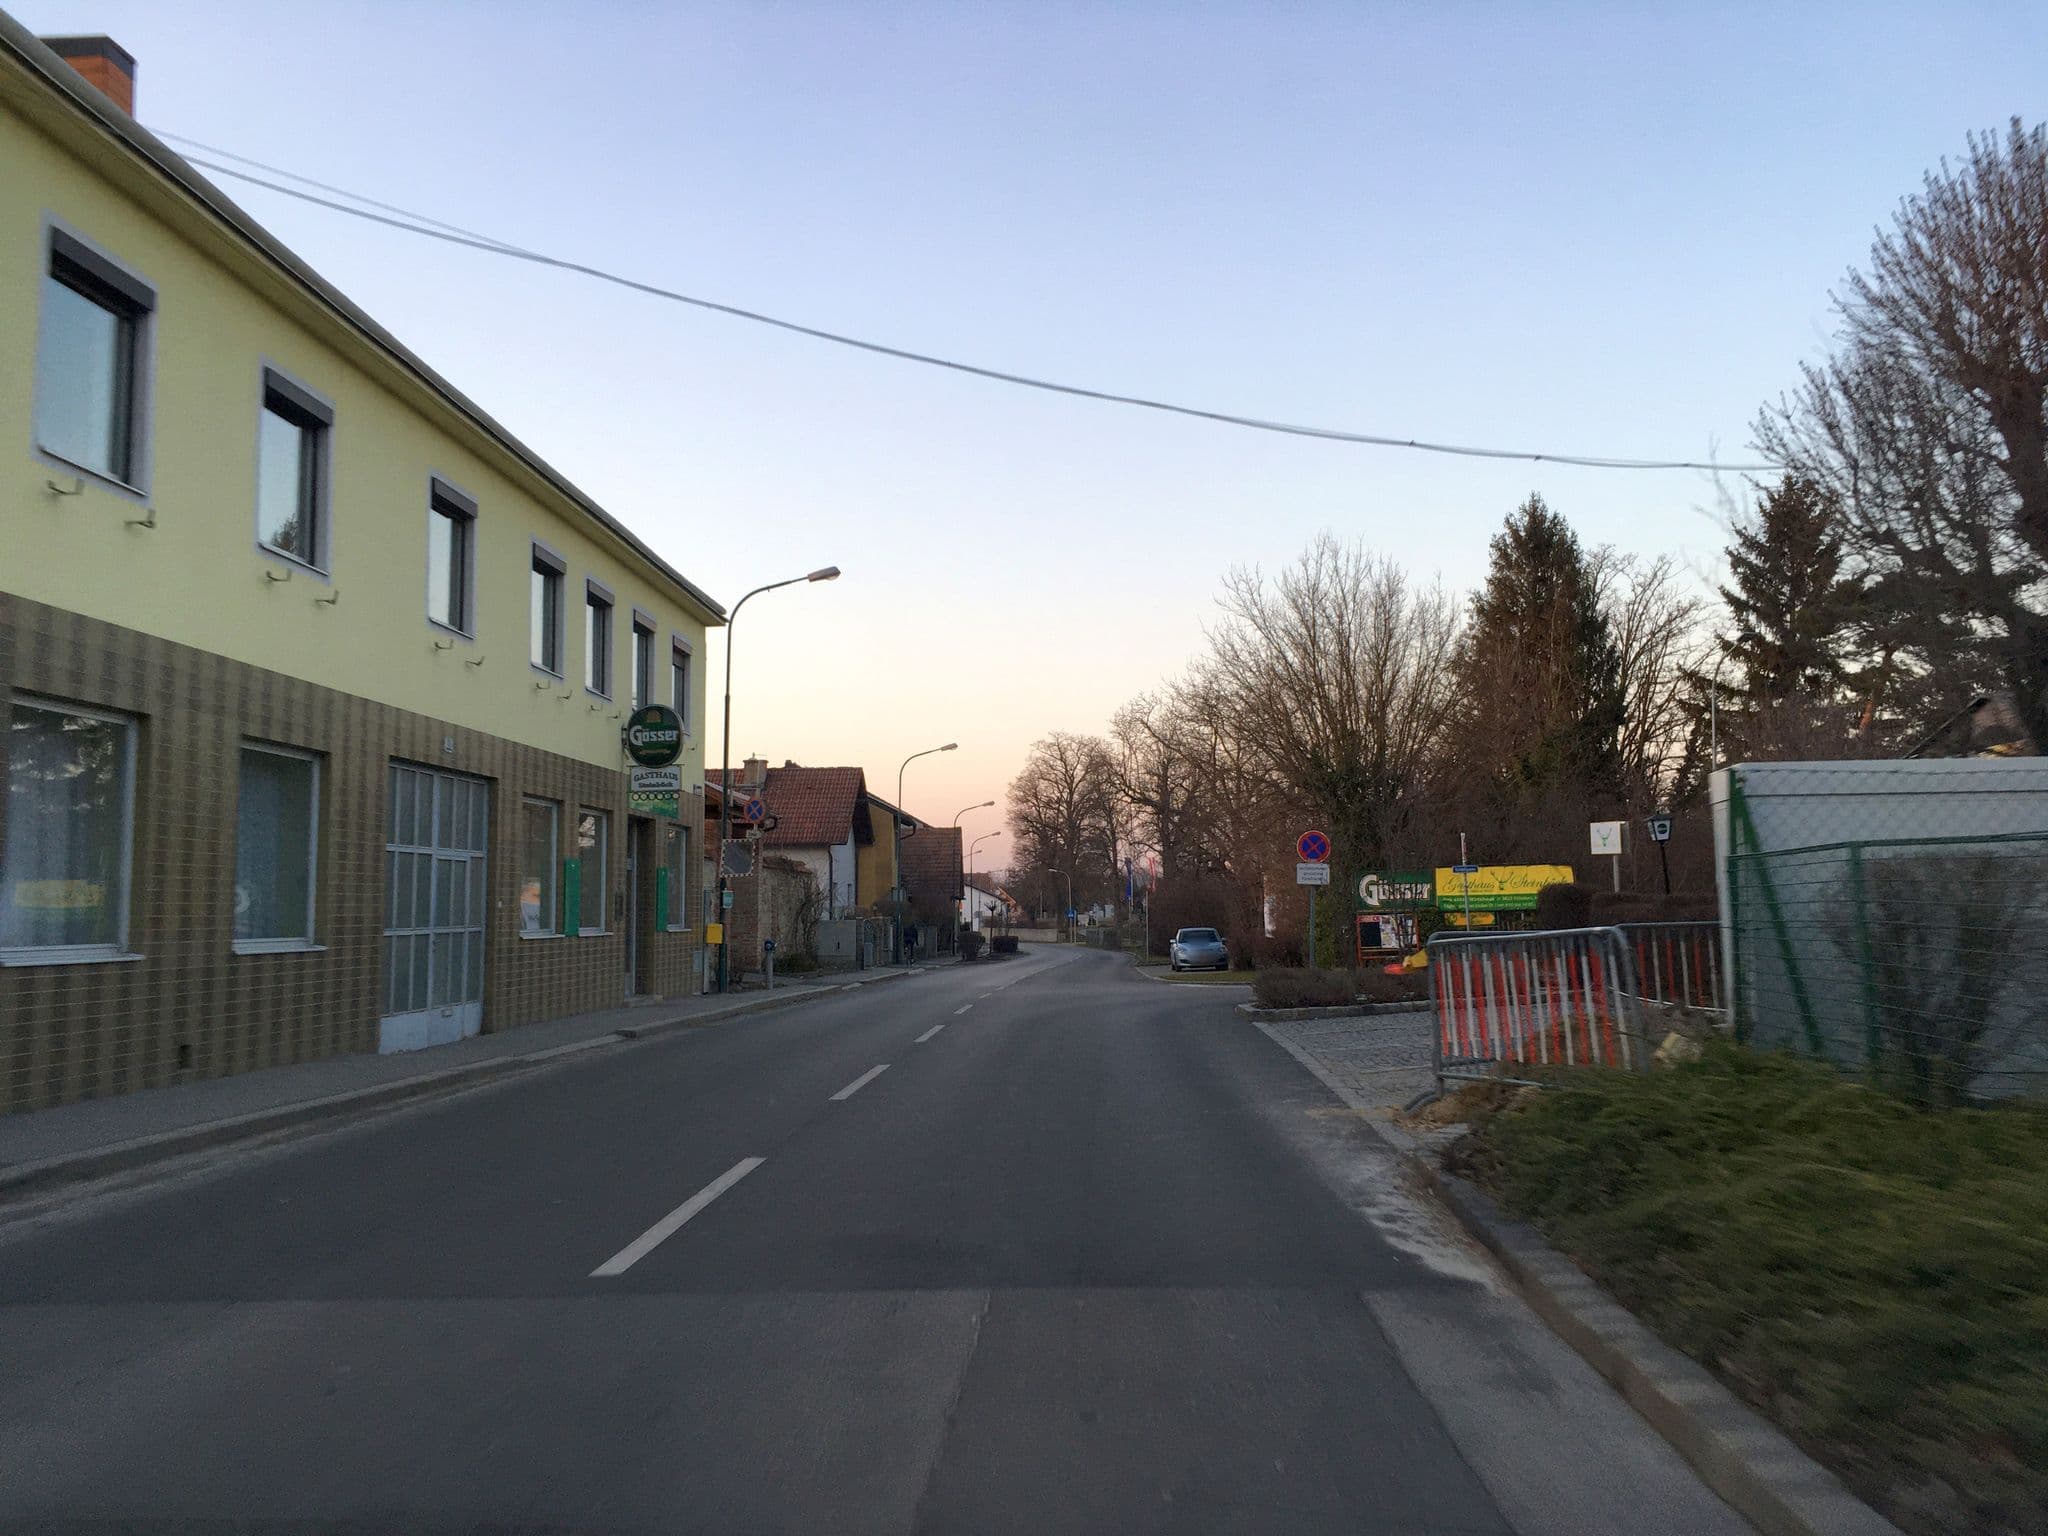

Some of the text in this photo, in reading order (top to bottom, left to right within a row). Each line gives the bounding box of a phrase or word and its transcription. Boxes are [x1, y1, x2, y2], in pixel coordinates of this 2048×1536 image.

[630, 725, 679, 746] Gösser
[633, 771, 678, 782] GASTHAUS
[1442, 876, 1496, 892] Gathaus
